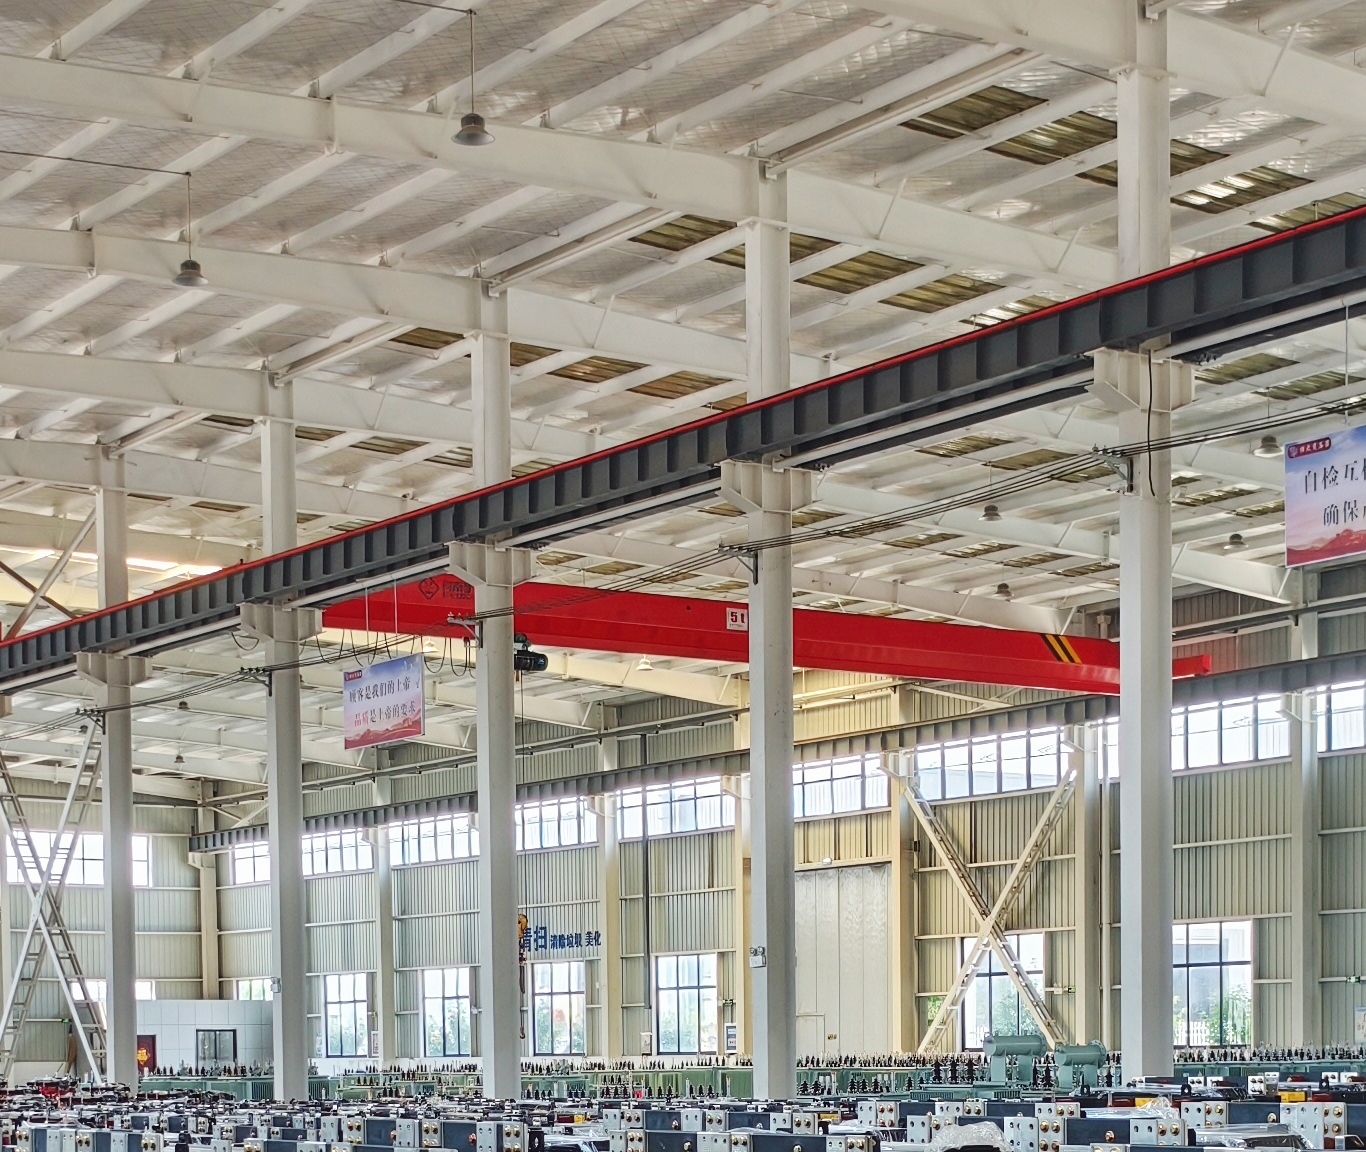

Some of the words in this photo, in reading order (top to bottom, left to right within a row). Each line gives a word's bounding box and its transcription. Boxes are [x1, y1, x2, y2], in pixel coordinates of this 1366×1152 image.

[349, 676, 411, 704] 顾客是我们的上帝
[354, 701, 416, 727] 品质是上帝的要求
[585, 930, 602, 947] 美化
